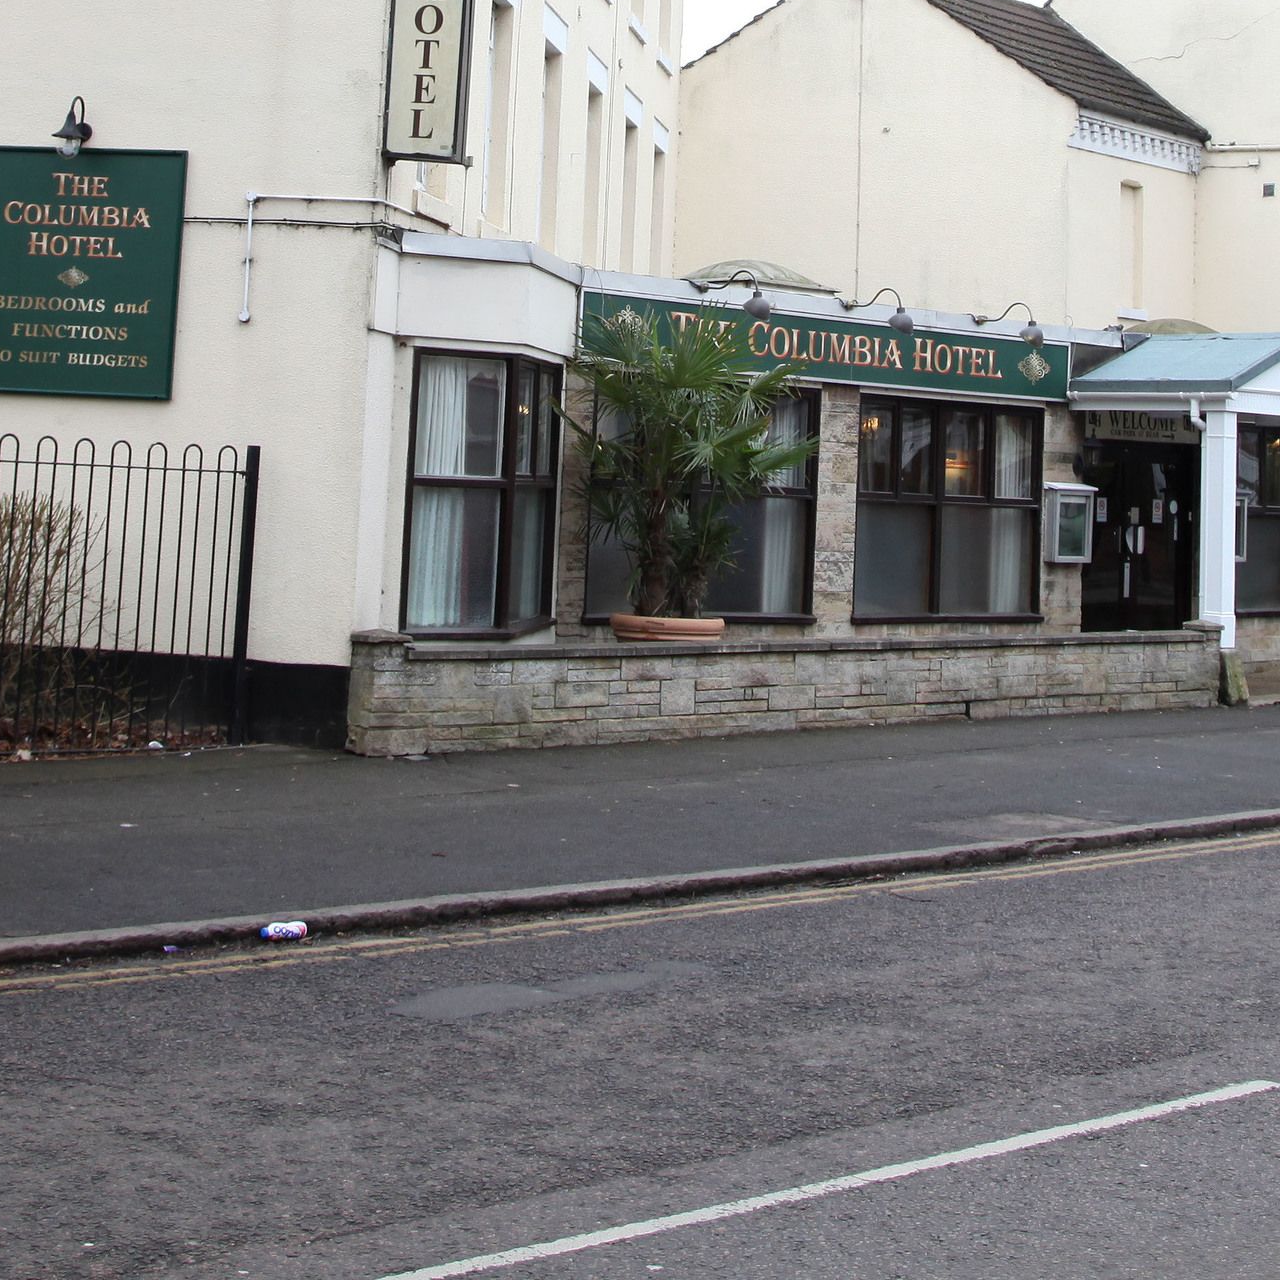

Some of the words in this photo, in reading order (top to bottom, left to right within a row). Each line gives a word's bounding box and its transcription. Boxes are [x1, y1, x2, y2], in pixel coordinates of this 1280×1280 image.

[52, 172, 109, 197] THE
[3, 200, 151, 228] COLUMBIA
[27, 231, 123, 258] HOTEL
[114, 300, 151, 314] and
[11, 322, 128, 341] FUNCTIONS
[18, 351, 60, 364] SUIT
[68, 353, 148, 368] BUDGETS
[748, 321, 903, 369] COLUMBIA
[913, 338, 1003, 379] HOTEL
[1109, 410, 1177, 432] WELCOME
